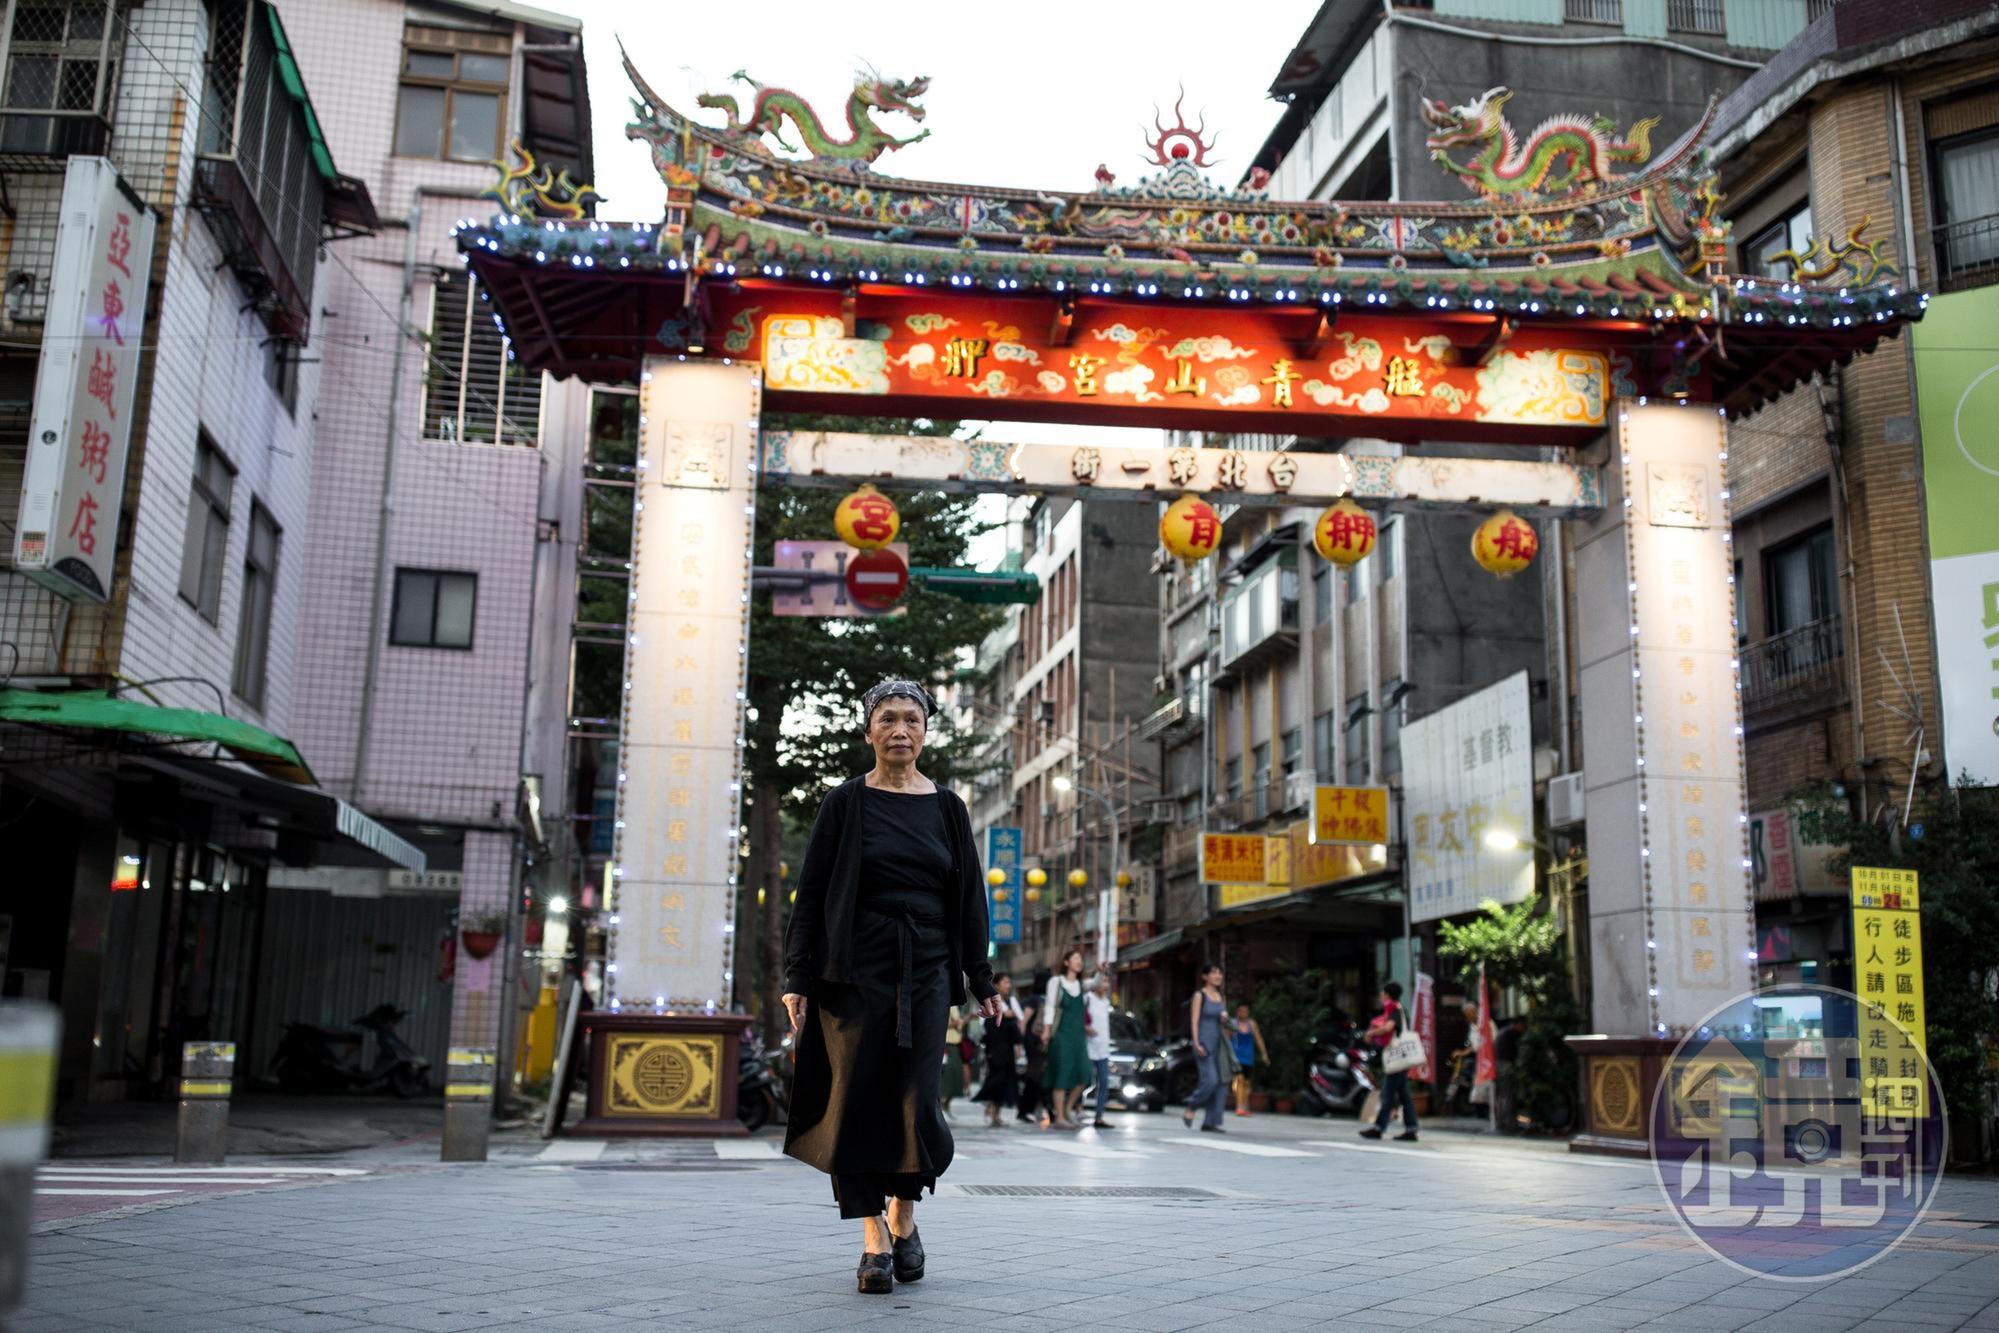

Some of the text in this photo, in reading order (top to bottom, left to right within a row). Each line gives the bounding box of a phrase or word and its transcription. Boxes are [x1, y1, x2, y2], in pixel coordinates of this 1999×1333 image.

[69, 211, 131, 556] 亞東鹹粥店
[849, 494, 896, 542] 宮
[1183, 502, 1222, 549] 青
[1463, 722, 1513, 772] 基督教
[1865, 916, 1890, 1107] 行人請改走騎樓
[1894, 918, 1920, 1108] 徒步區施工封閉
